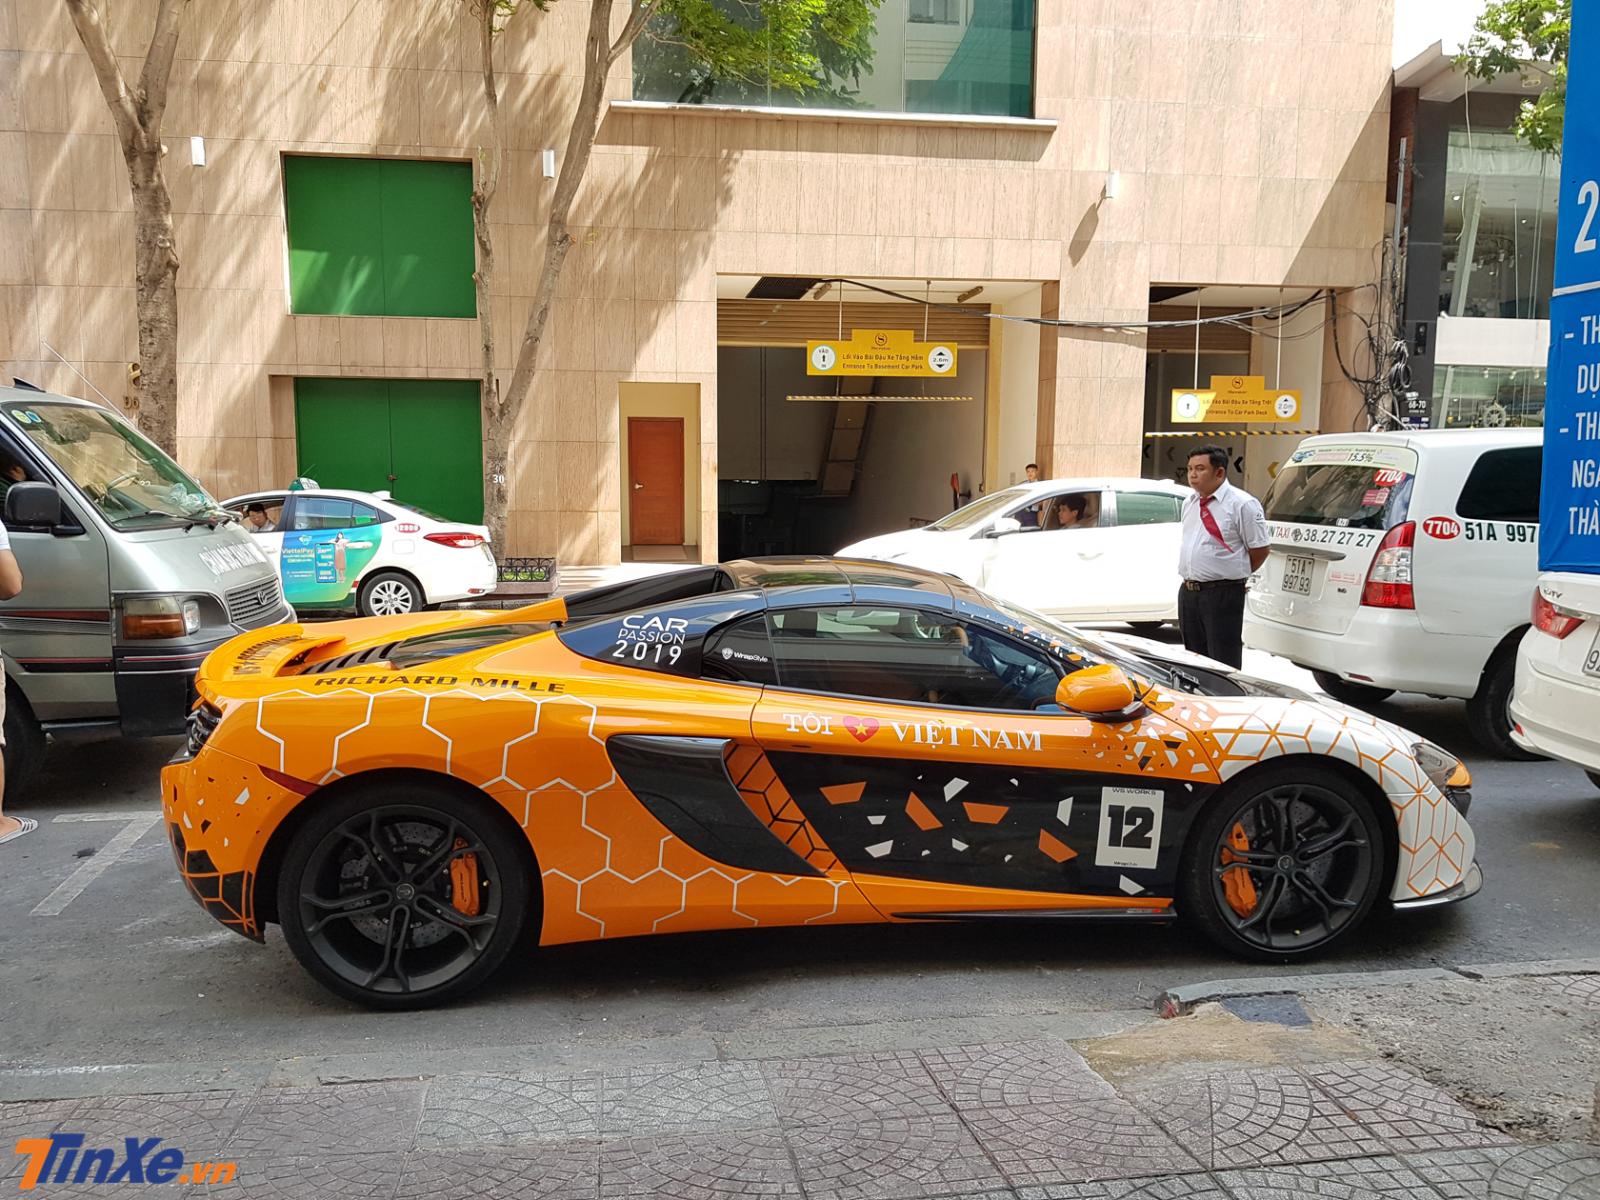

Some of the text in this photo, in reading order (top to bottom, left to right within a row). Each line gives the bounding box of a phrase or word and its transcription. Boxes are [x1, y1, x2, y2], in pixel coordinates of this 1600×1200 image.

[842, 362, 866, 370] Entrance
[1575, 411, 1600, 440] TH
[492, 474, 505, 484] 30
[1376, 469, 1404, 483] 7704
[1425, 519, 1460, 536] 7704
[1465, 522, 1537, 543] 51A 997
[1337, 531, 1354, 545] 27
[1356, 533, 1376, 548] 27
[623, 614, 689, 633] CAR
[617, 628, 686, 645] PASSION
[612, 639, 682, 666] 2019
[314, 675, 566, 693] RICHARD MILLE
[783, 713, 1043, 751] TÔI VIỆT NAM
[1107, 804, 1155, 850] 12
